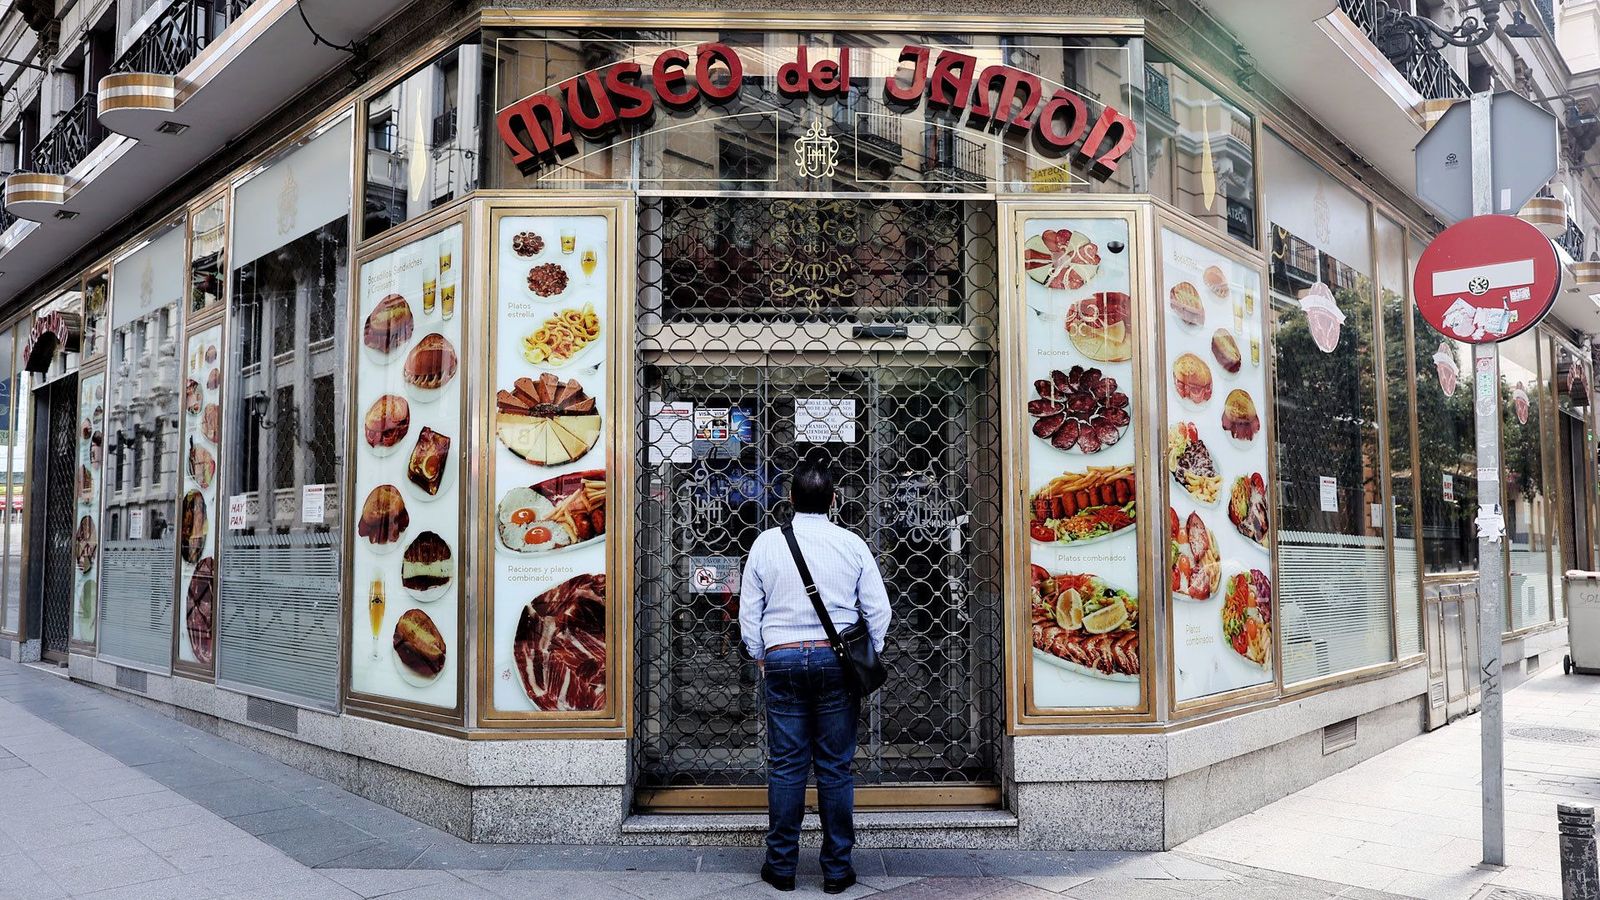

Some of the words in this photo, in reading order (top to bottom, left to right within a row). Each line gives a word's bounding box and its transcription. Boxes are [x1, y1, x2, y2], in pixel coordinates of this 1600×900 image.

[496, 41, 743, 168] MUSEO
[777, 45, 850, 94] del
[508, 302, 531, 310] Platos
[1038, 348, 1070, 356] Raciones
[231, 503, 245, 513] HAY
[230, 516, 244, 526] PAN
[1058, 554, 1081, 562] Platos
[1083, 554, 1127, 562] combinados
[507, 565, 542, 573] Raciones
[544, 566, 548, 575] y
[550, 565, 574, 575] platos
[507, 574, 553, 582] combinados
